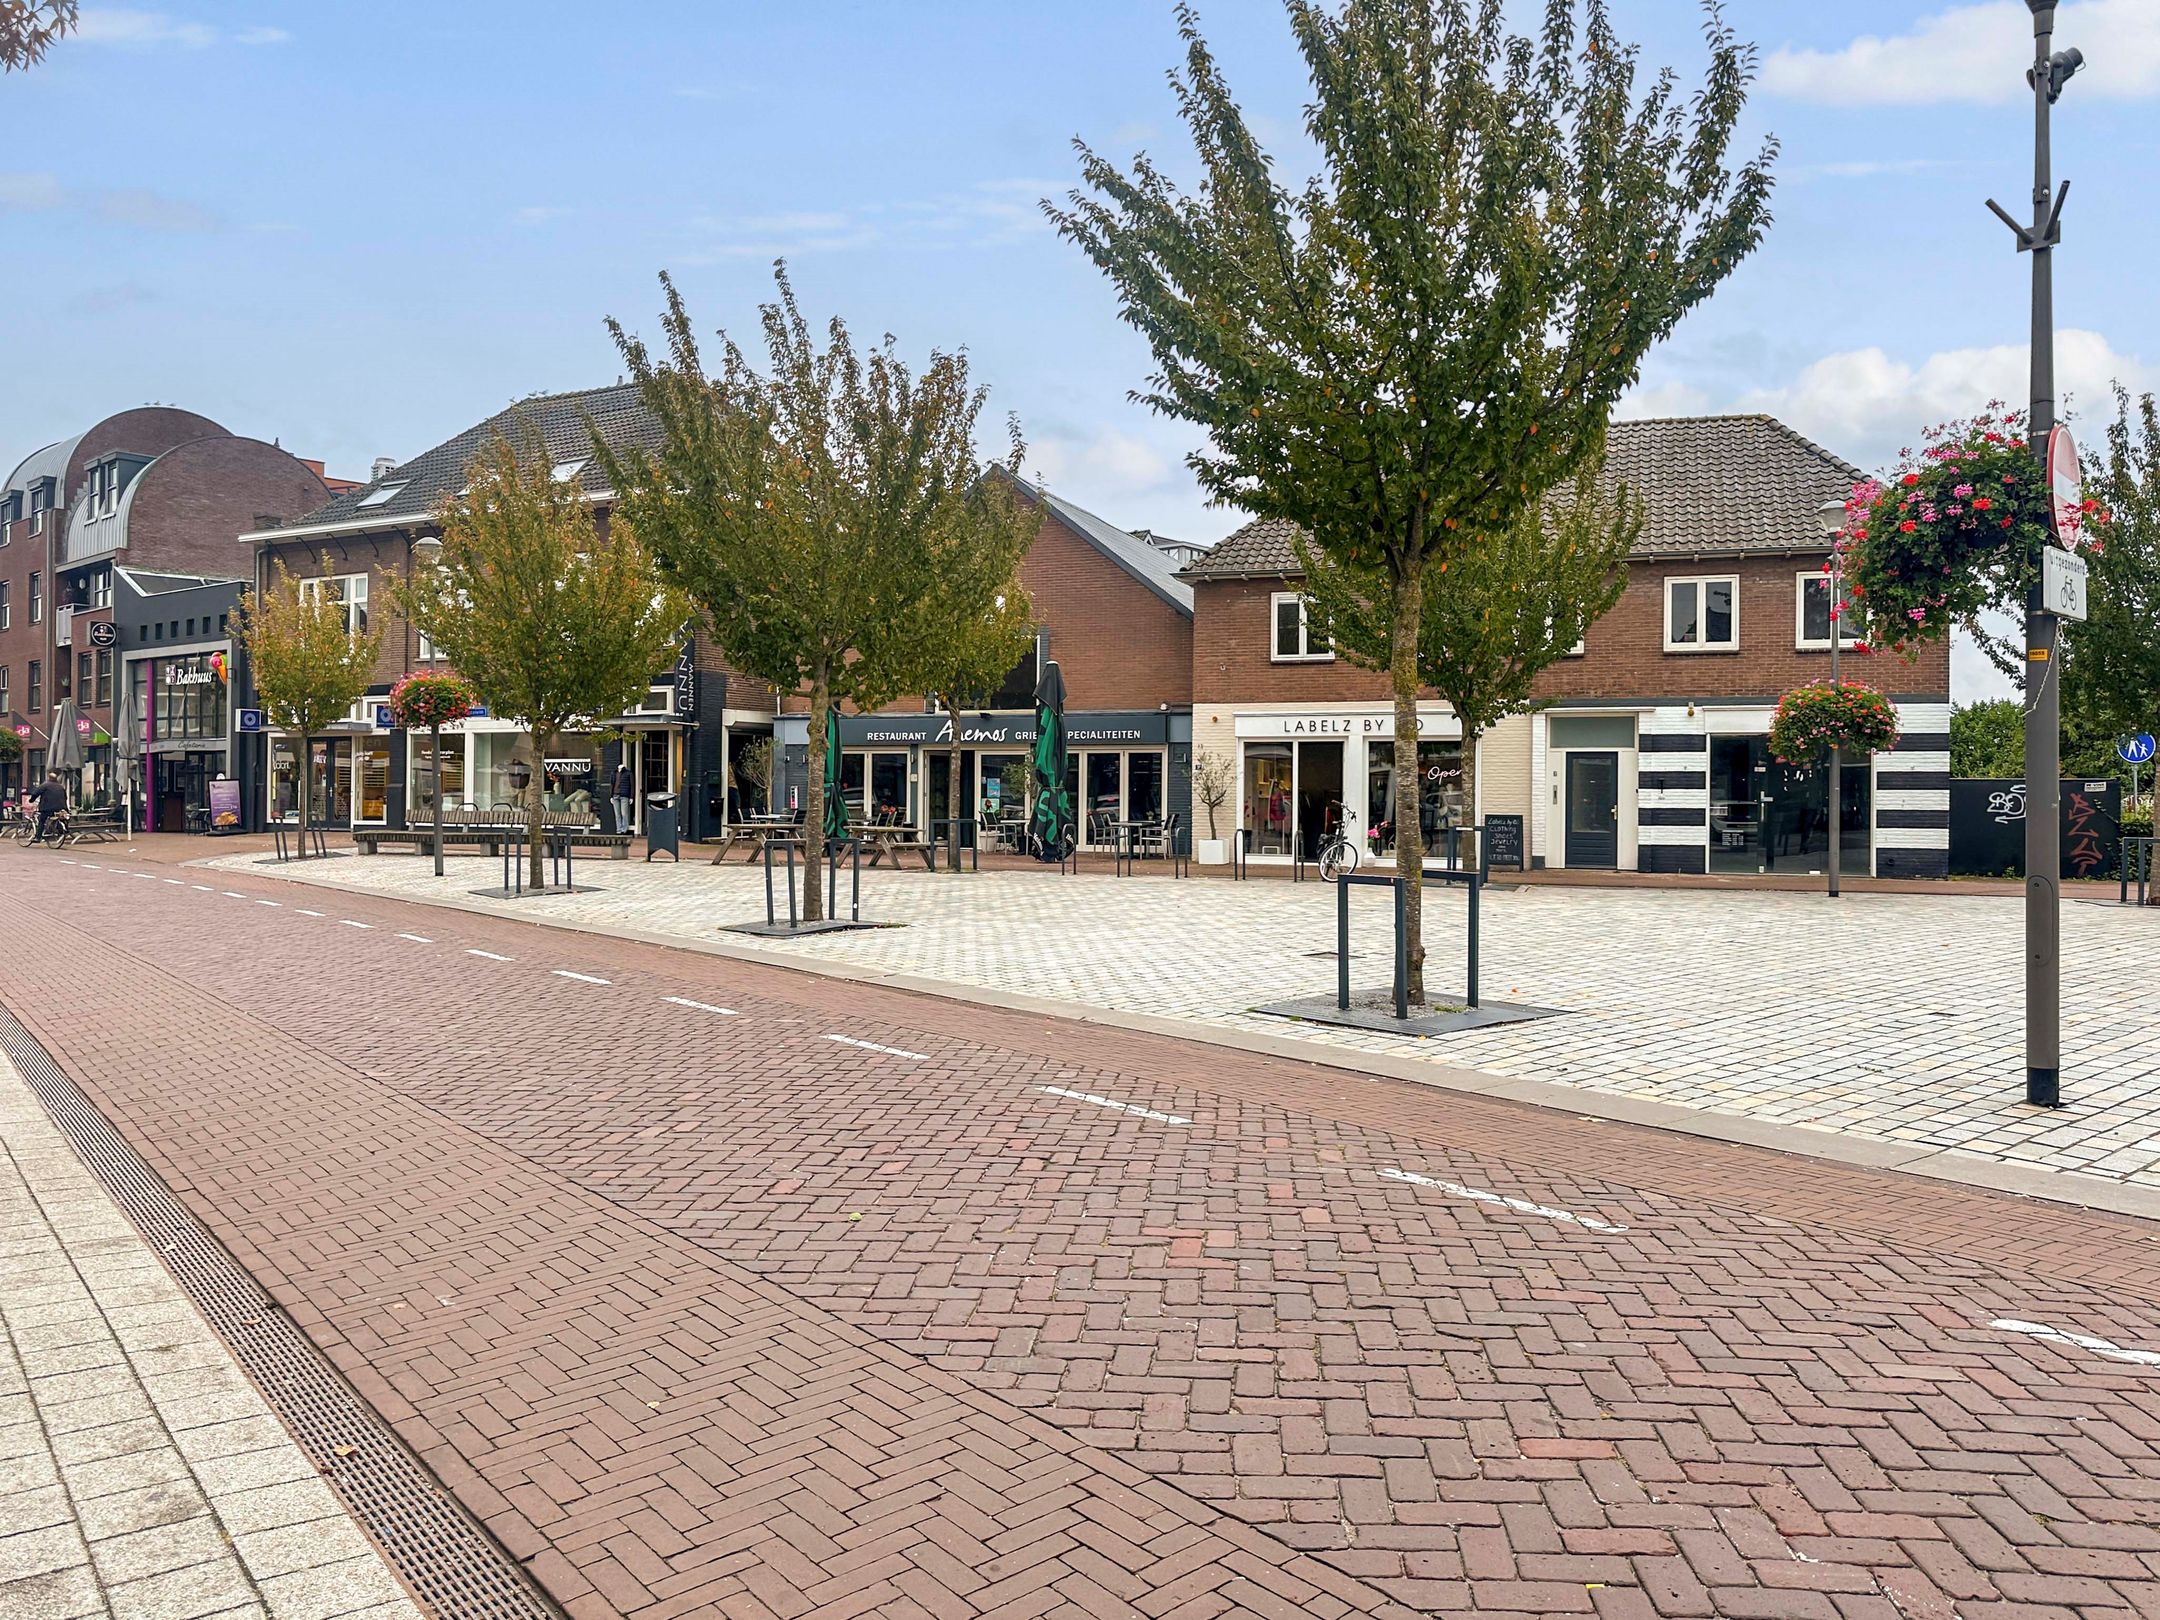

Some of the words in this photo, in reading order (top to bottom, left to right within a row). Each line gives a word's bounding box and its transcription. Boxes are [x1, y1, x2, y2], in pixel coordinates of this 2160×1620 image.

[176, 666, 212, 685] Bakhuus
[1284, 720, 1350, 732] LABELZ
[1364, 719, 1384, 731] BY
[867, 732, 927, 741] RESTAURANT
[1015, 731, 1037, 740] GRIE
[1067, 730, 1141, 740] PECIALITEITEN
[544, 763, 591, 772] VANNU
